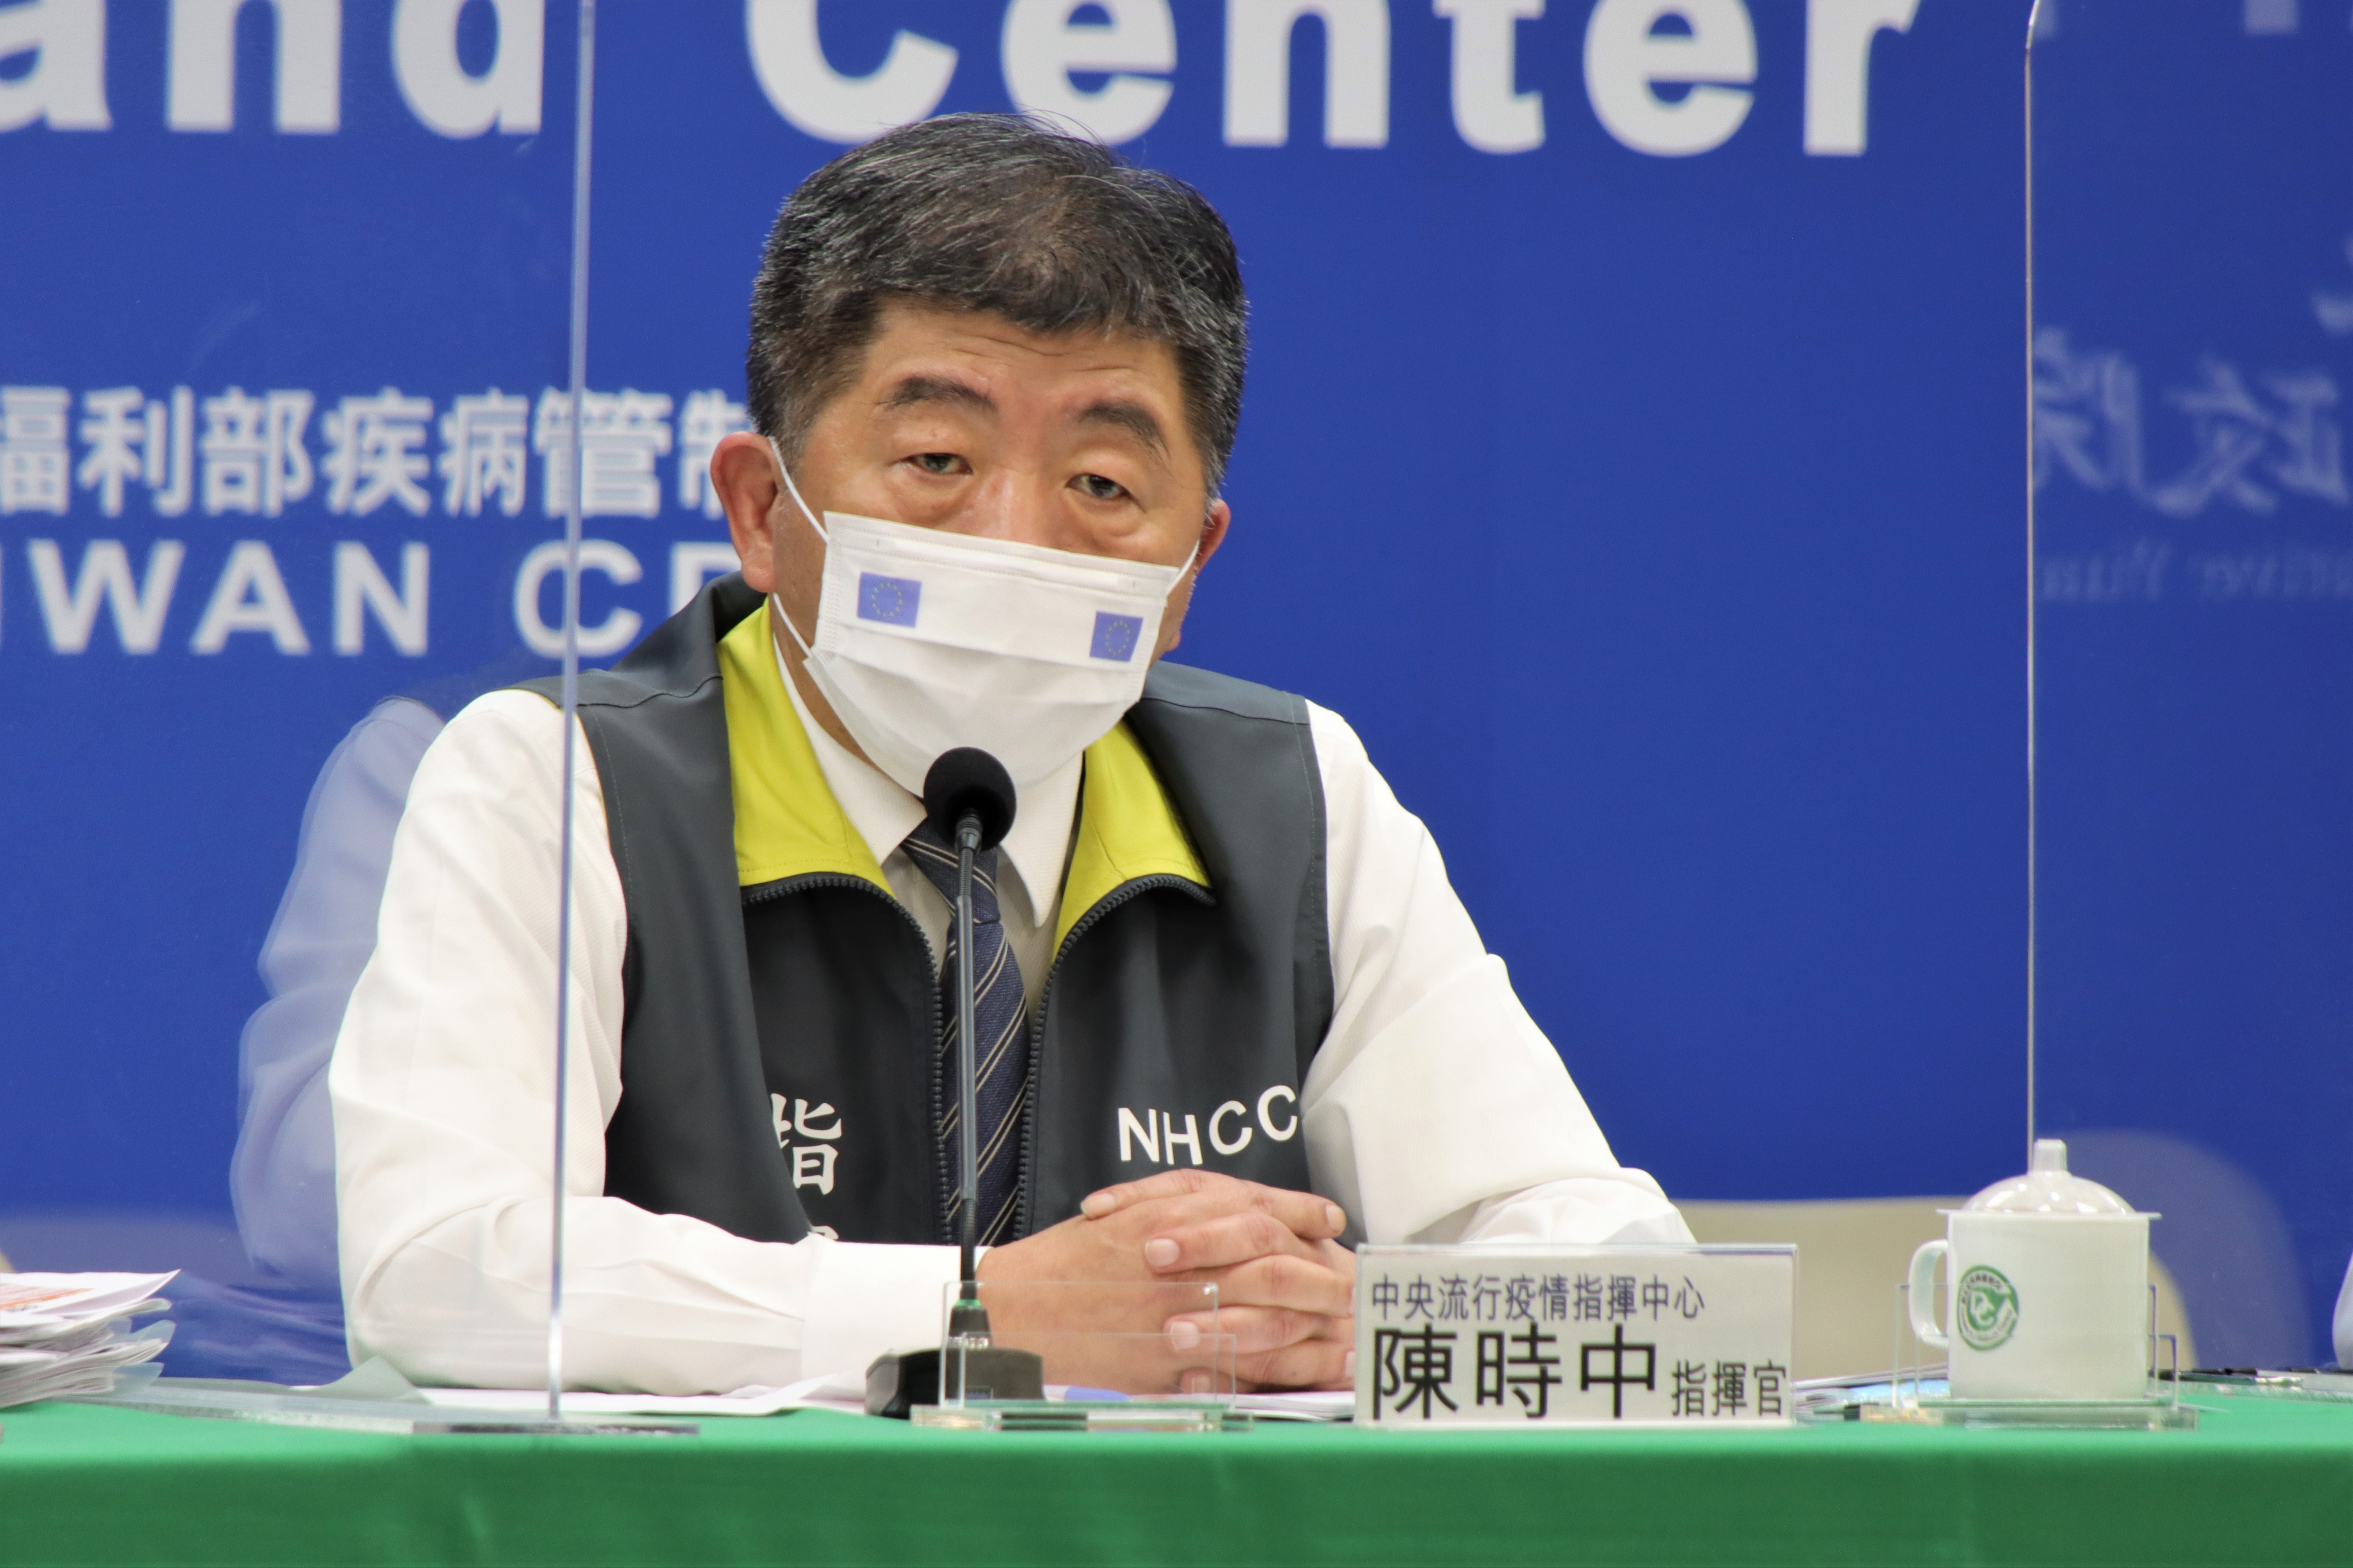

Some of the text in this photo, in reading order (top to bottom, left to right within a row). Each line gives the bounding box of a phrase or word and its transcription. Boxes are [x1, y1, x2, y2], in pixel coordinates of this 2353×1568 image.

[0, 0, 1920, 156] and Center
[0, 538, 430, 657] WAN
[770, 1093, 843, 1240] 指
[1118, 1085, 1298, 1166] NHCC
[1372, 1273, 1705, 1321] 中央流行疫情指揮中心
[1372, 1322, 1787, 1420] 陳時中 指揮官
